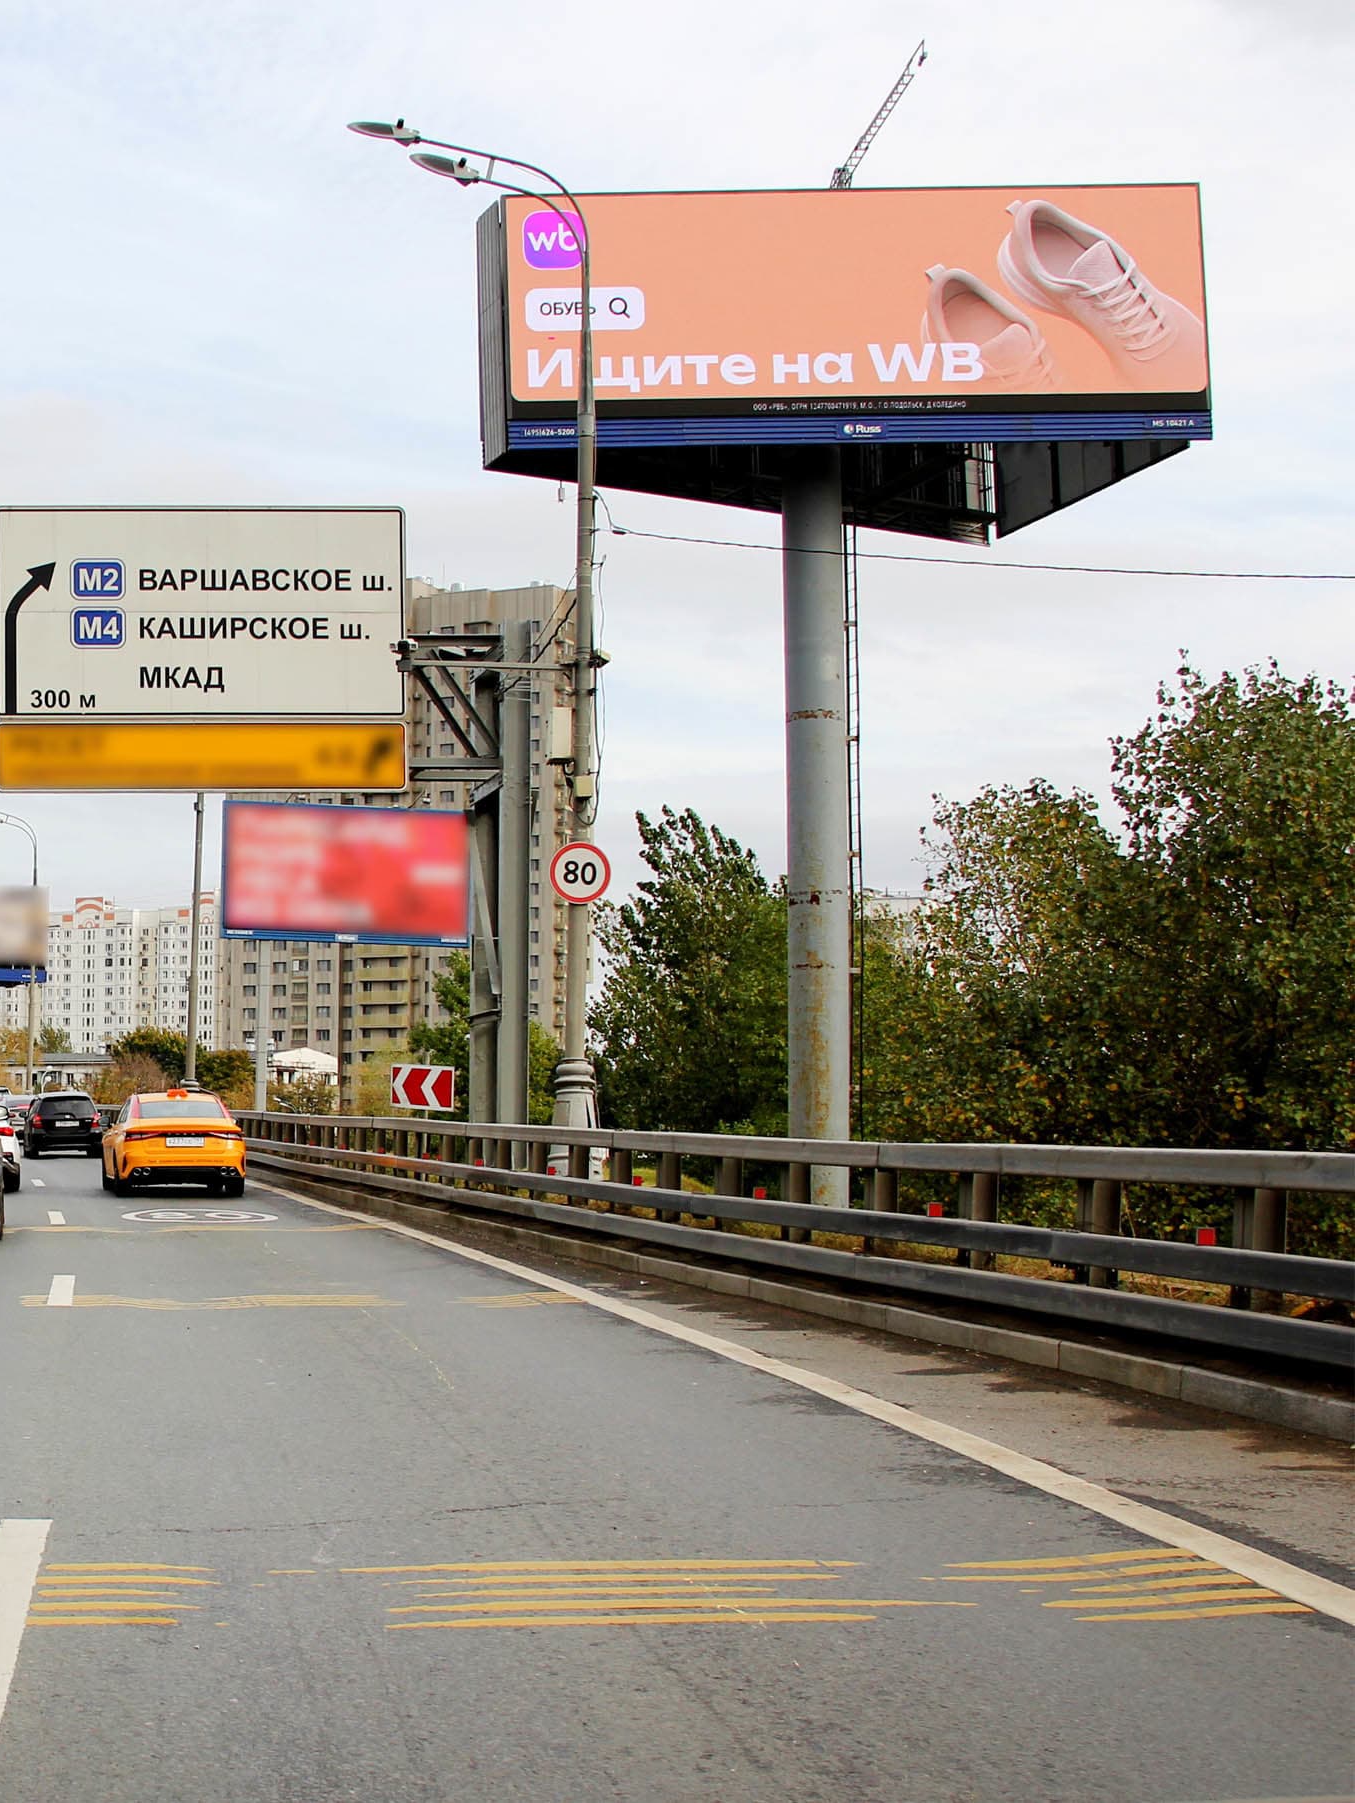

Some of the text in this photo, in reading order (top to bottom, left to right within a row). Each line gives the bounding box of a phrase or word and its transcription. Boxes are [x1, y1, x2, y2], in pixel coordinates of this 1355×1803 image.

[772, 353, 854, 384] на
[867, 342, 985, 383] WB
[855, 424, 882, 434] Russ
[78, 566, 394, 592] М2 ВАРШАВСКОЕ ш.
[78, 615, 371, 641] М4 КАШИРСКОЕ ш.
[138, 666, 226, 693] МКАД
[30, 689, 97, 709] 300 м
[563, 860, 598, 886] 80
